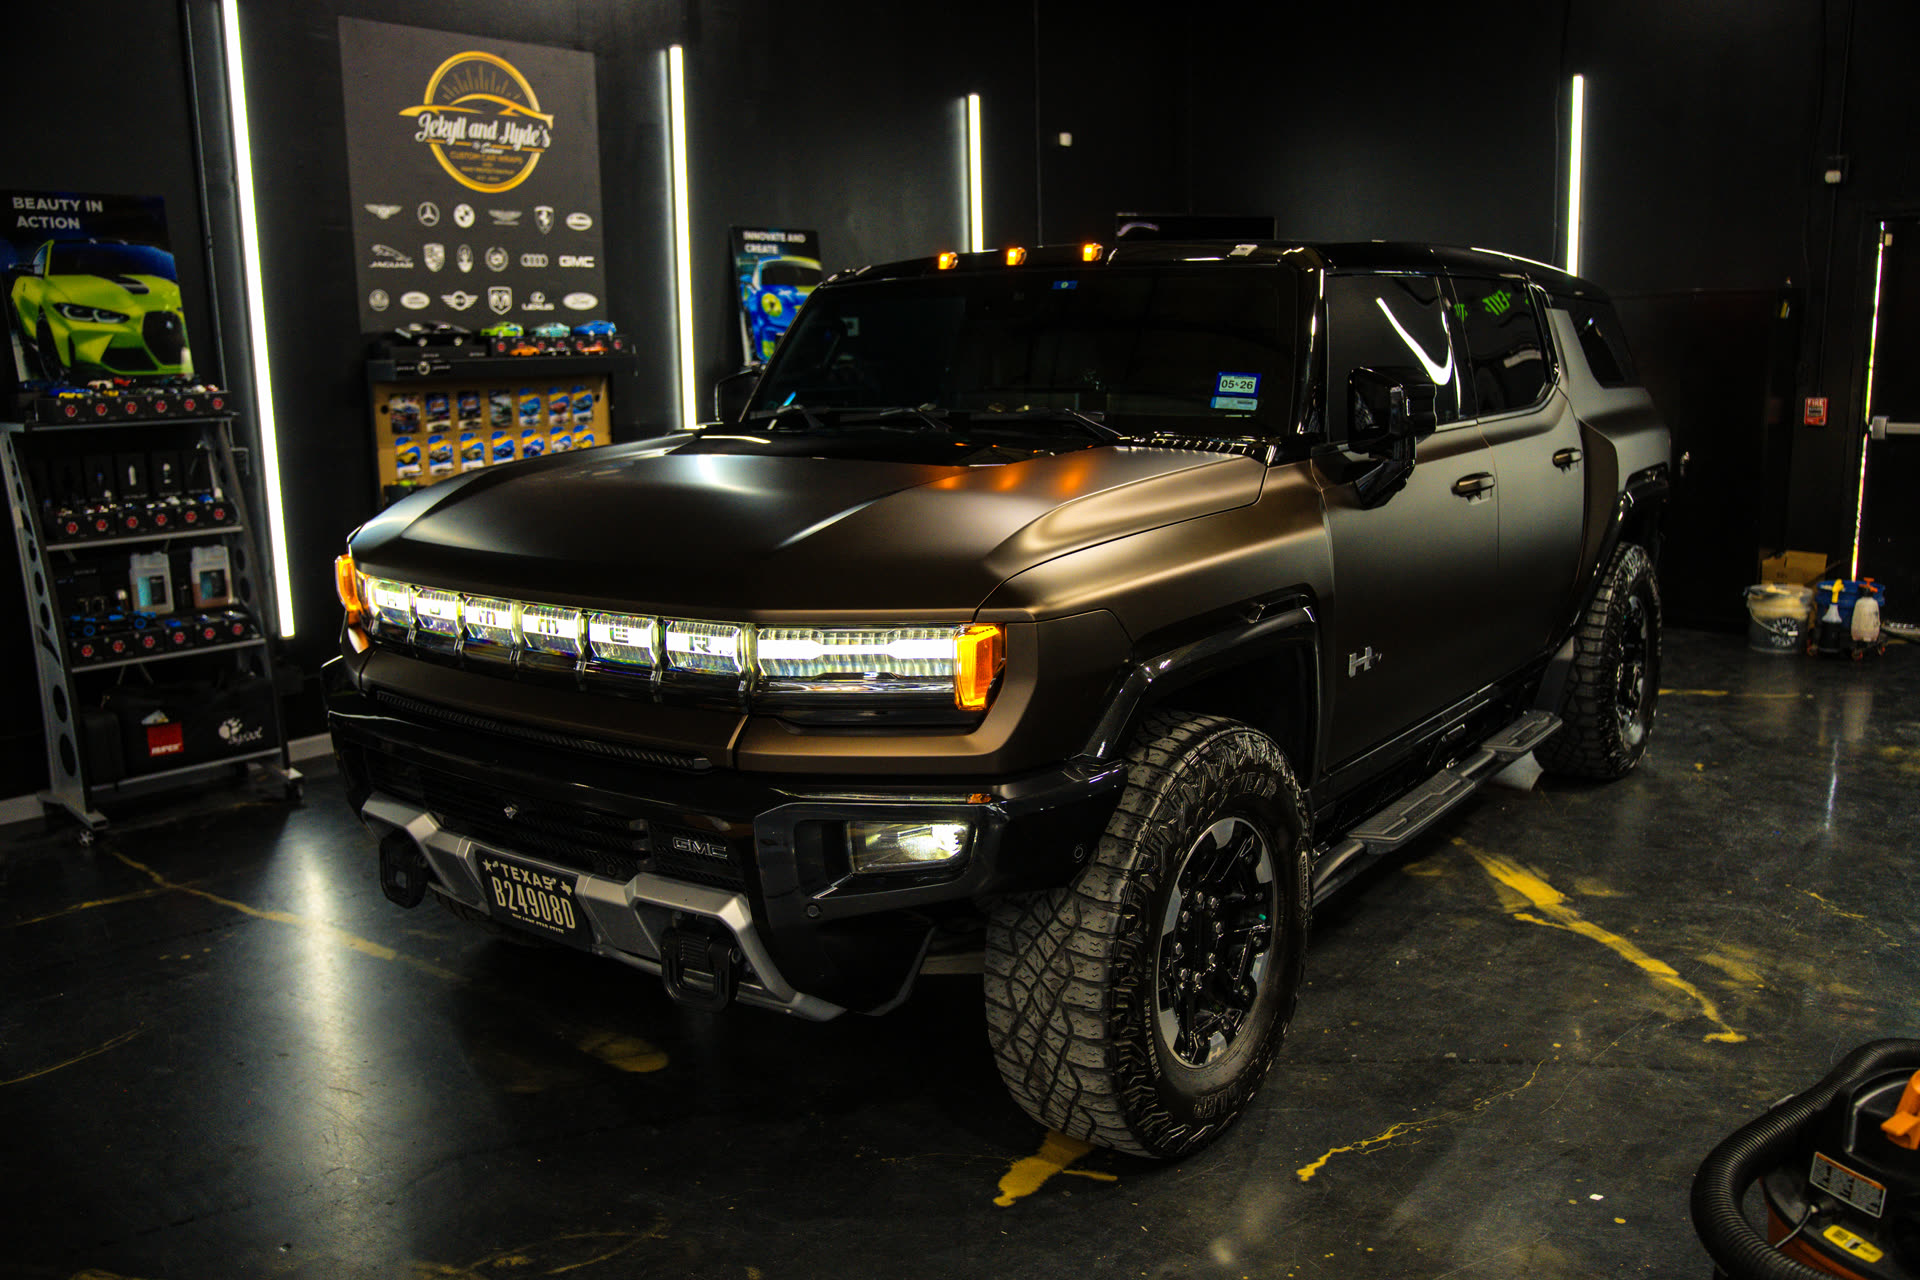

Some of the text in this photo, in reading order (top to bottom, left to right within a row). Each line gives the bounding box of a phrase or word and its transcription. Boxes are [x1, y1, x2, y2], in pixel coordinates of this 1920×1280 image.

[415, 113, 551, 151] Jekyll and Hyde's
[12, 197, 103, 212] BEAUTY IN
[16, 215, 80, 229] ACTION
[743, 231, 806, 244] INNOVATE AND
[744, 243, 779, 254] CREATE
[558, 255, 595, 268] GMC
[673, 837, 728, 859] GMC
[500, 863, 553, 892] TEXAS
